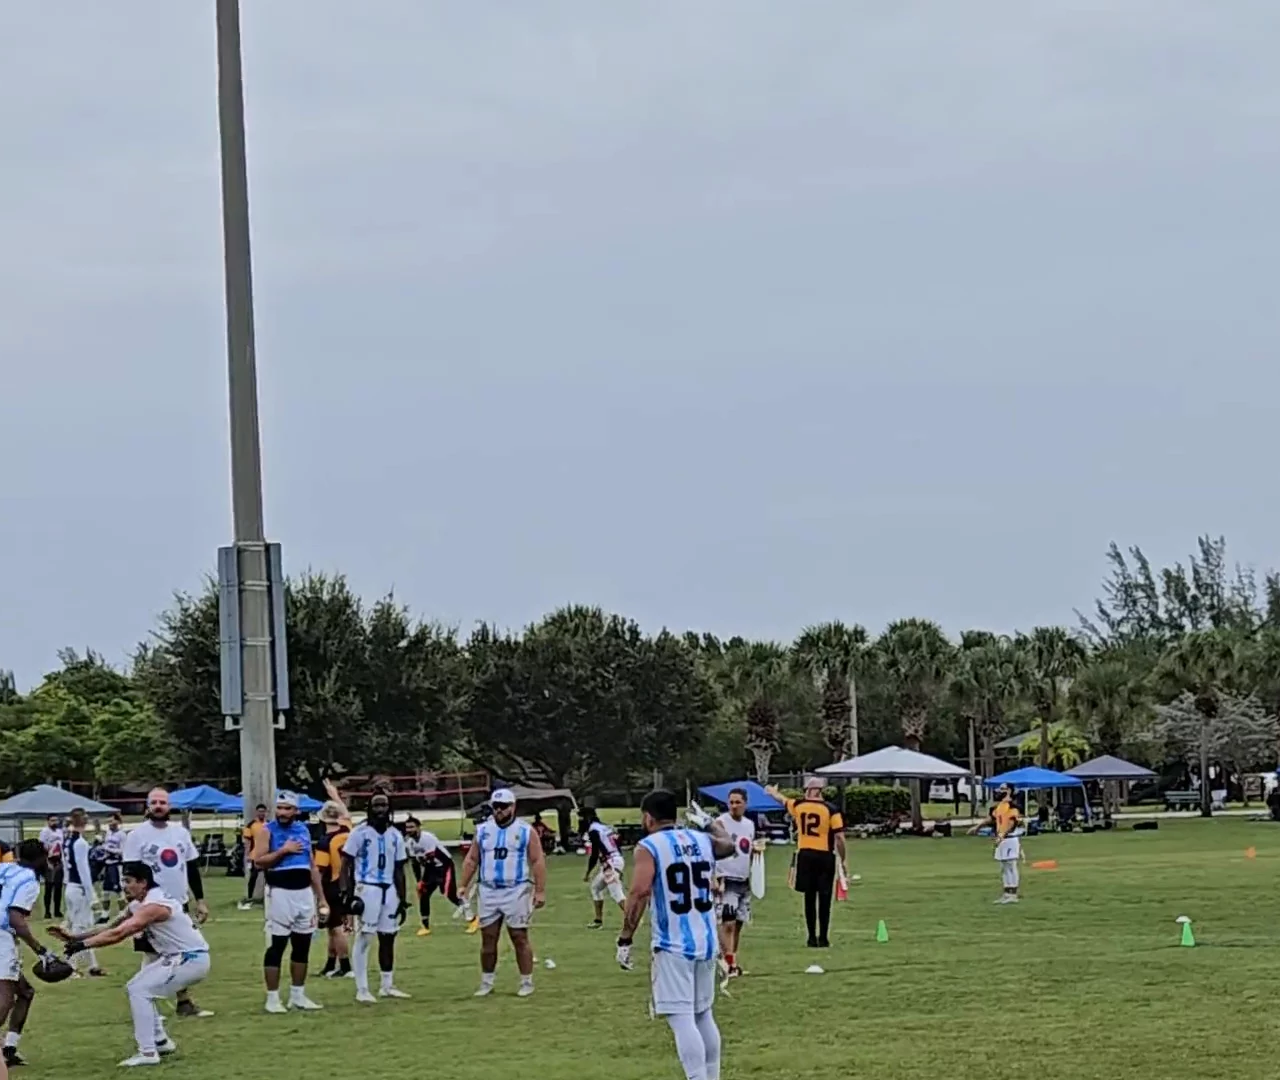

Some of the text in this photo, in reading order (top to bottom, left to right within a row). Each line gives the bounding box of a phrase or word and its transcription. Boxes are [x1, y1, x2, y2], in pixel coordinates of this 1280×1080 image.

[801, 812, 821, 837] 12
[493, 847, 508, 860] 10
[666, 861, 713, 915] 95
